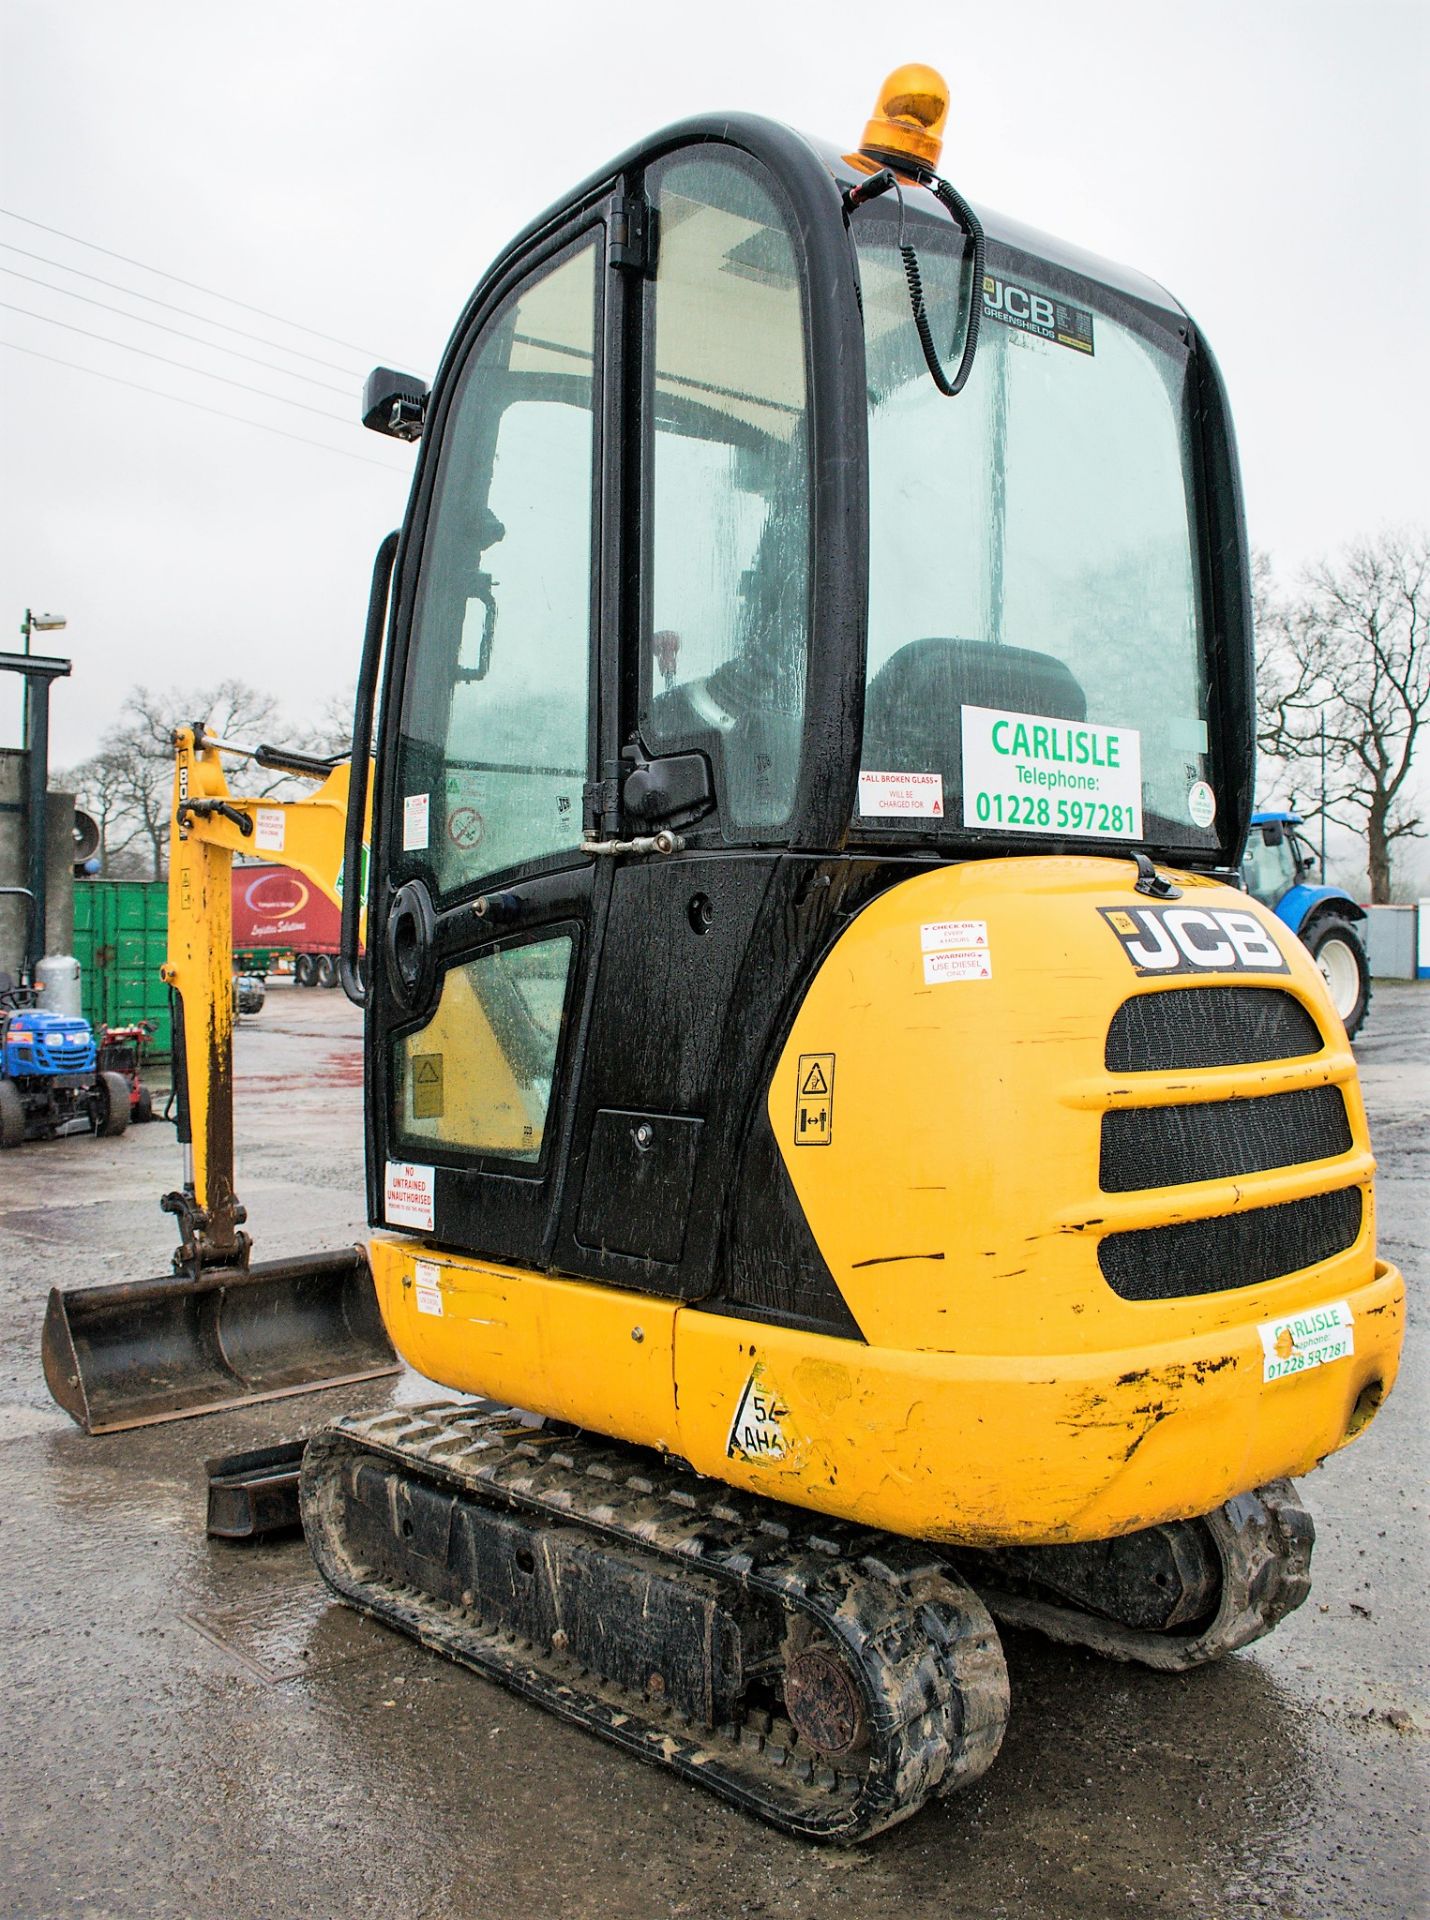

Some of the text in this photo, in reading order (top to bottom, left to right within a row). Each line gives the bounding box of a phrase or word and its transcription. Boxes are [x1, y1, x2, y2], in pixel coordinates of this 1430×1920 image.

[983, 280, 1055, 329] JCB
[984, 306, 1055, 339] GREENSHIELDS
[991, 720, 1121, 768] CARLISLE
[865, 775, 934, 784] ALL BROKEN GLASS
[1015, 765, 1099, 791] Telephone:
[879, 800, 911, 809] CHARGED
[976, 791, 1134, 833] 01228 597281
[1126, 910, 1283, 969] JCB
[932, 960, 982, 971] USE DIESEL
[936, 952, 976, 960] WARNING
[405, 1166, 414, 1177] NO
[392, 1178, 426, 1192] UNTRAINED
[387, 1190, 432, 1206] UNAUTHORISED
[1268, 1341, 1347, 1379] 01228 597281
